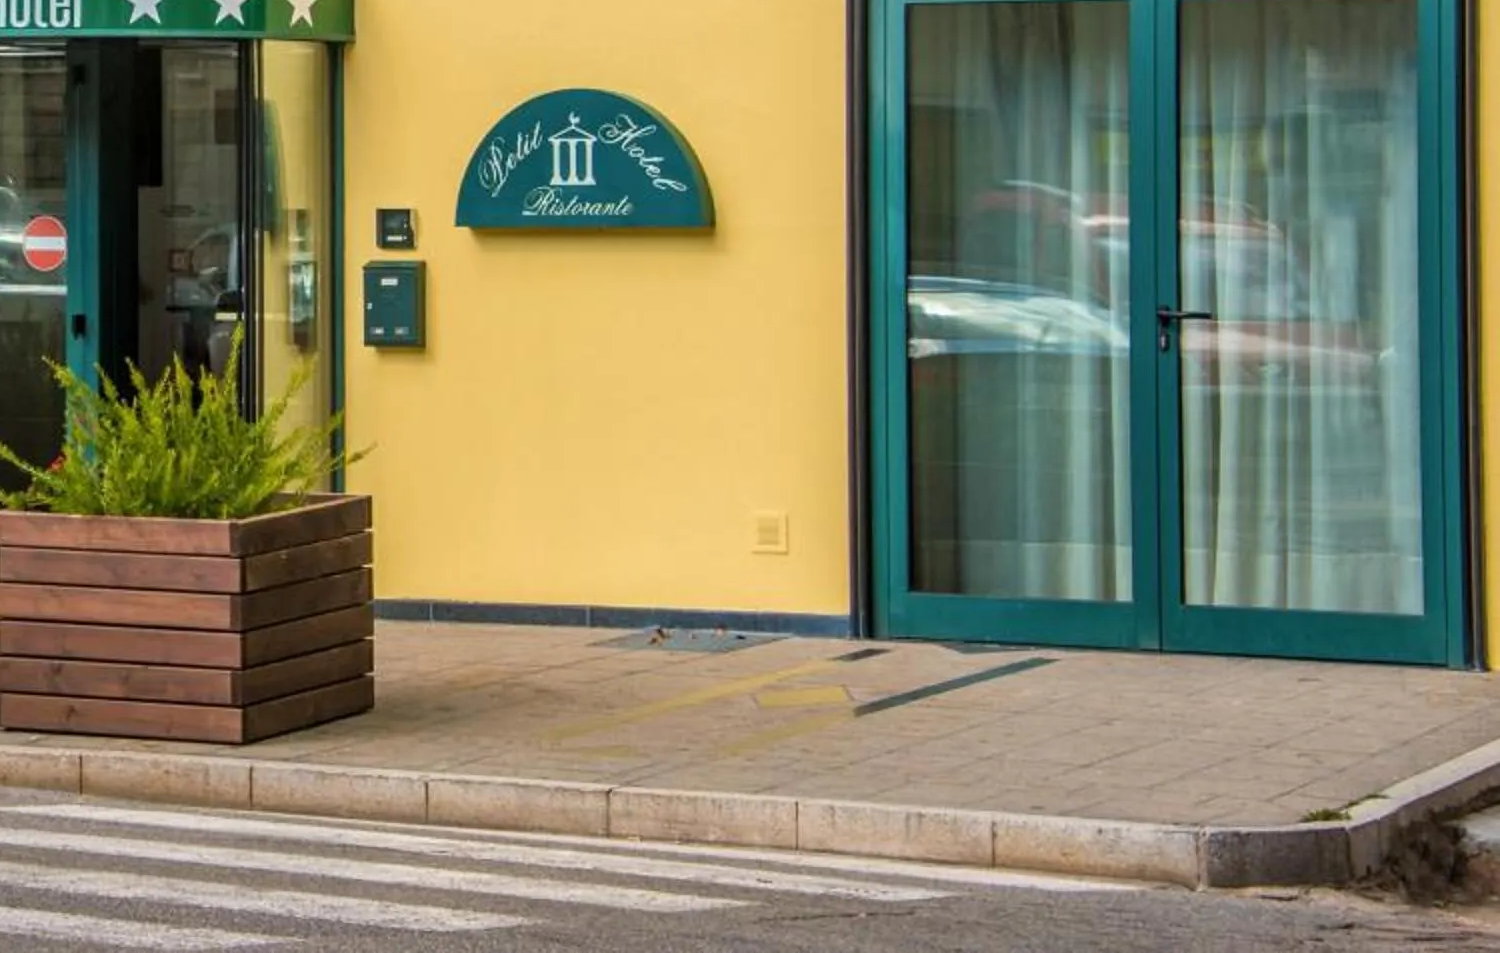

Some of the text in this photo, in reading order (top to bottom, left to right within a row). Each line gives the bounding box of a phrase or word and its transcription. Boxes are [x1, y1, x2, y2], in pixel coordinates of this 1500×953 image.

[478, 113, 687, 197] Petit Hotel
[521, 186, 634, 216] Ristorante
